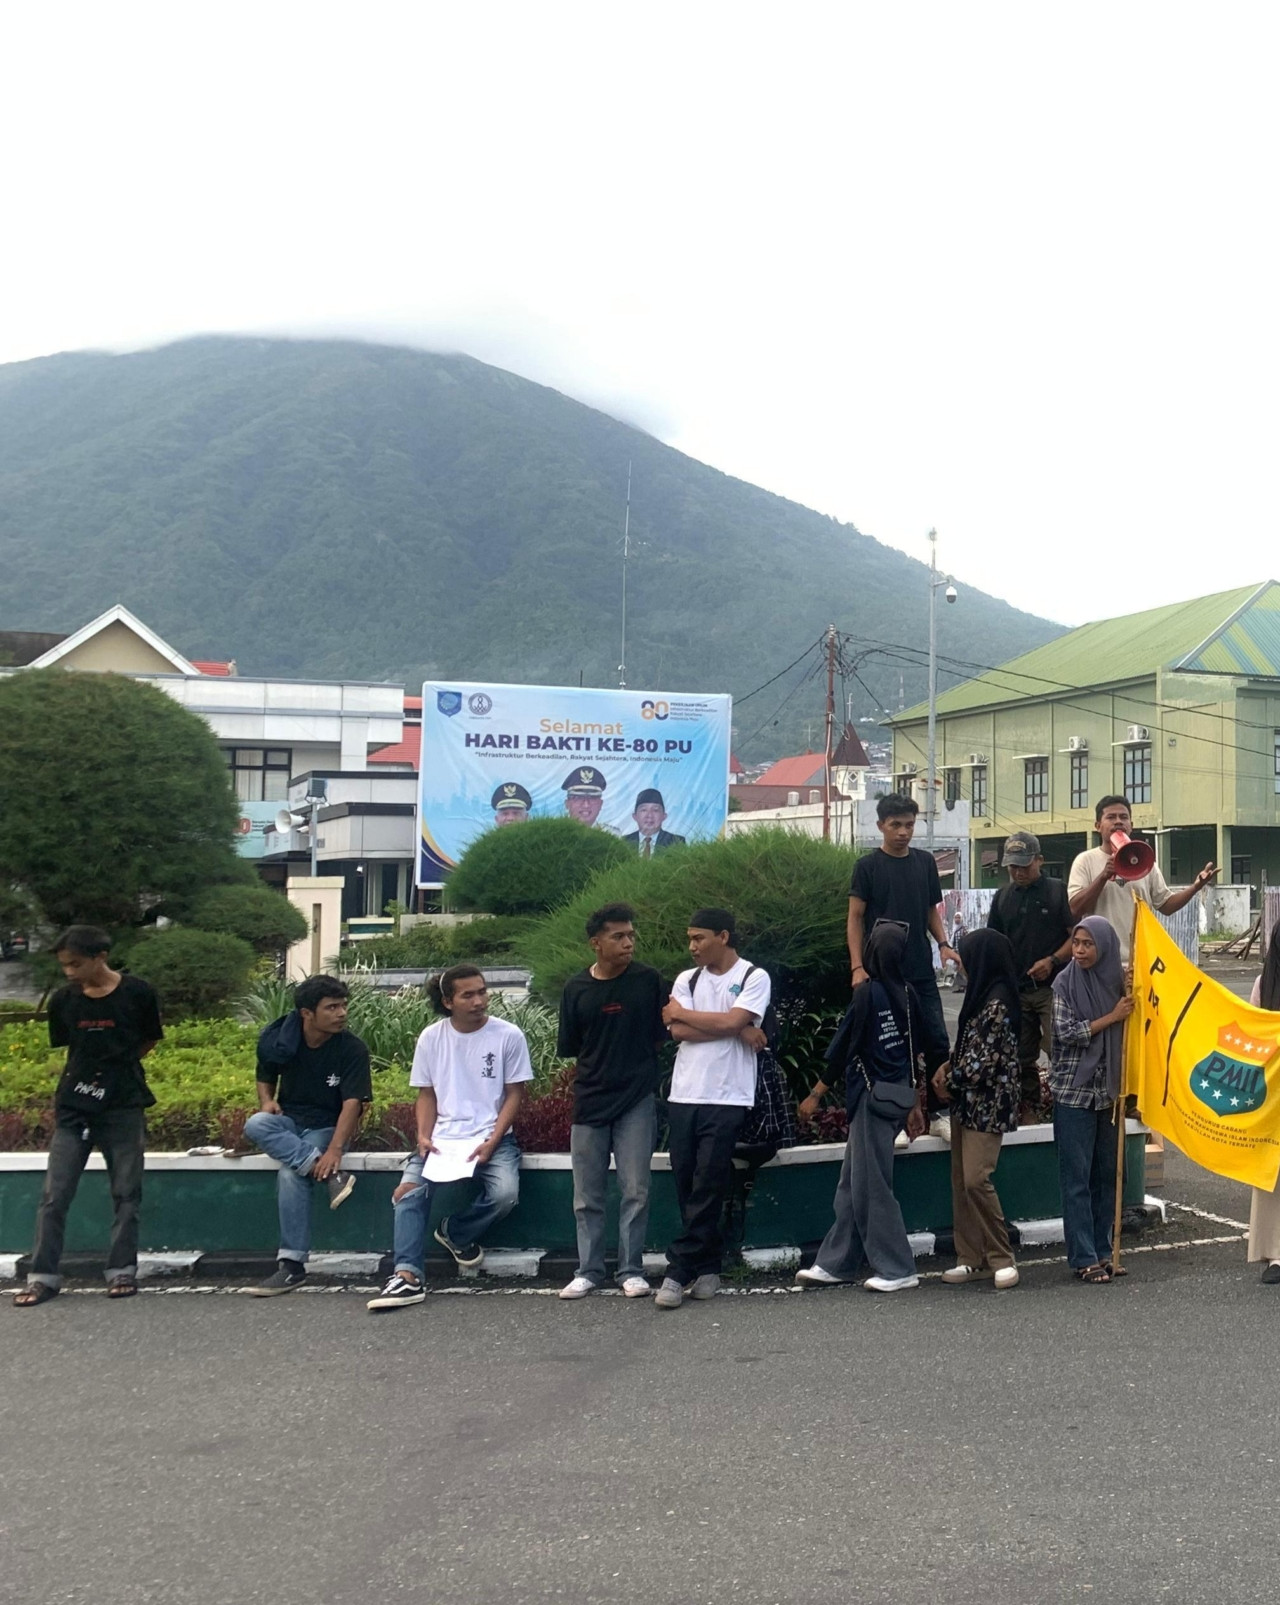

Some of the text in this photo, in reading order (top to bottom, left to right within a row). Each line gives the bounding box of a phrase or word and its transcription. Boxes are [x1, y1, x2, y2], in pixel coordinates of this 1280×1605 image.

[539, 718, 623, 735] Selamat
[465, 733, 692, 754] HARI BAKTI KE-80 PU
[525, 753, 570, 761] Berkeadilan,
[570, 754, 594, 762] Rakyat
[595, 755, 628, 763] Sejahtera,
[481, 1051, 497, 1079] 書道
[1204, 1056, 1262, 1095] PMII
[74, 1082, 105, 1100] PAPUA
[1221, 1125, 1248, 1135] CABANG
[1211, 1136, 1227, 1144] KOTA
[1229, 1141, 1256, 1149] TERNATE
[1228, 1134, 1248, 1142] ISLAM
[1248, 1137, 1280, 1146] INDONESIA
